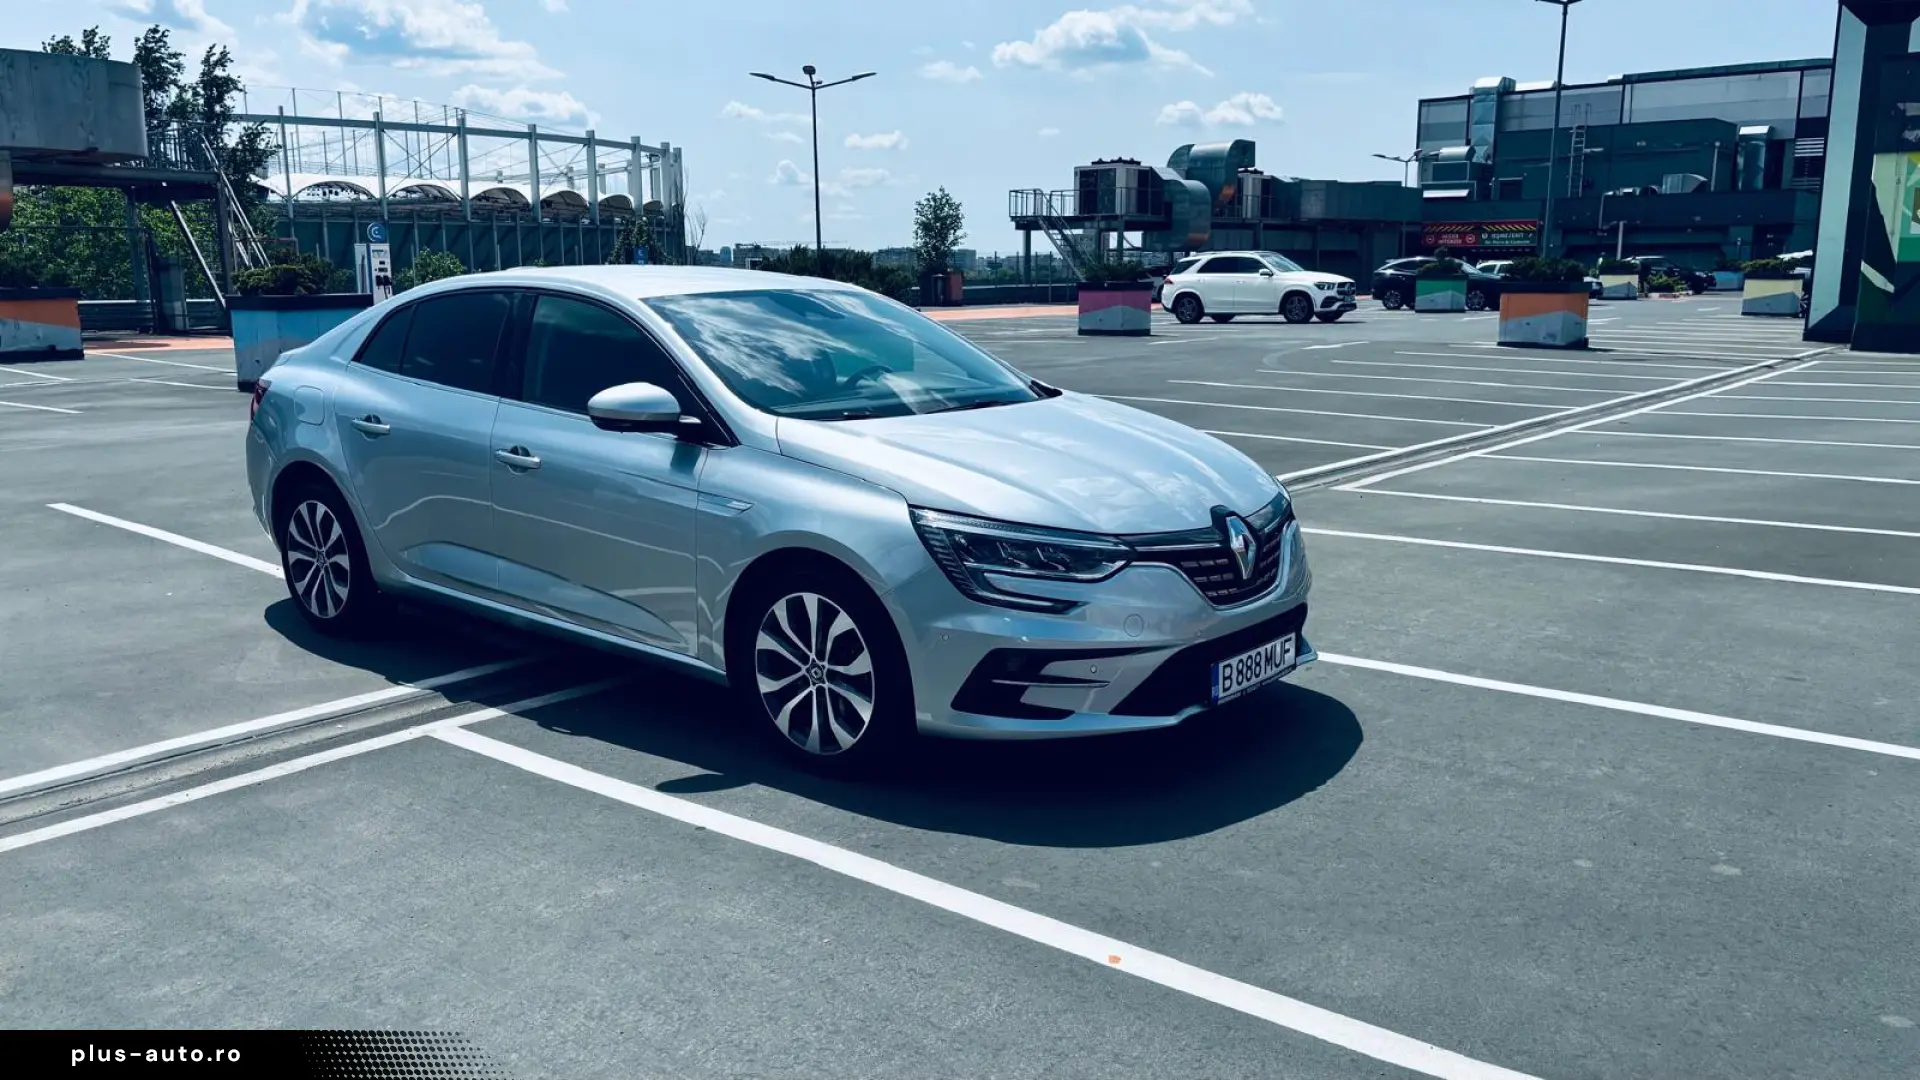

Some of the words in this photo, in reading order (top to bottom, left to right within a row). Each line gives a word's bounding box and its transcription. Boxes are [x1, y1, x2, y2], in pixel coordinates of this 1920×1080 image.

[1222, 663, 1233, 693] B
[1236, 651, 1262, 686] 888
[1264, 636, 1293, 675] MUF
